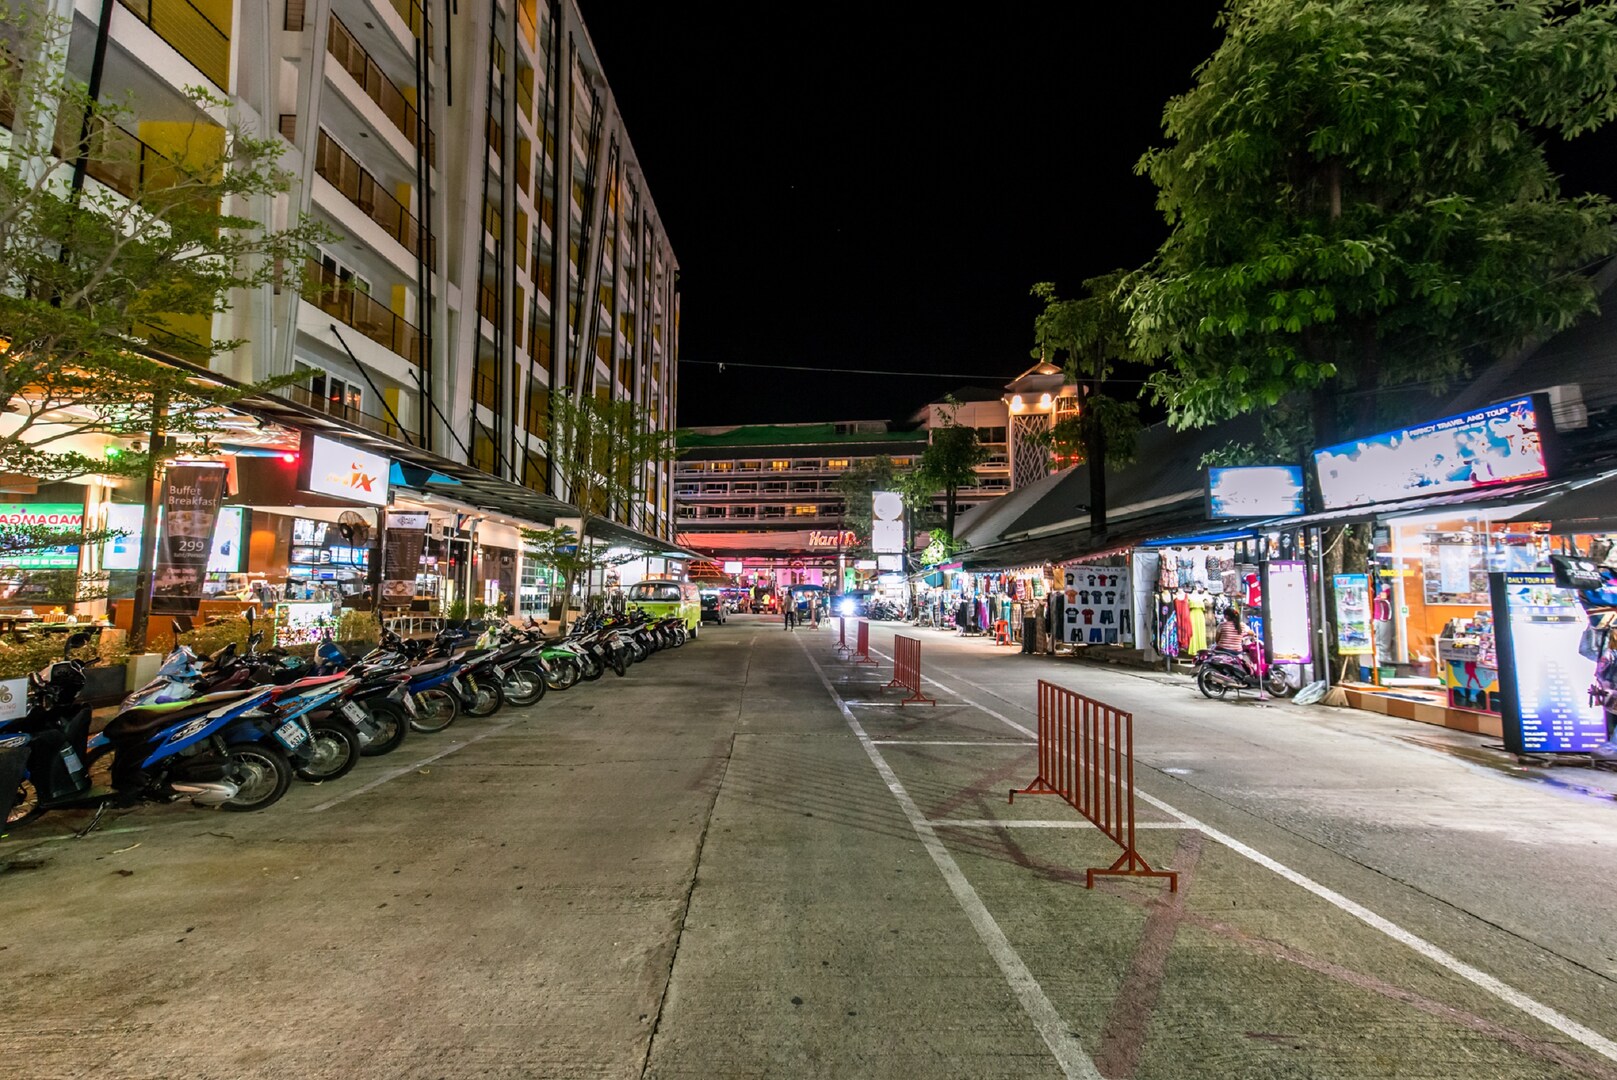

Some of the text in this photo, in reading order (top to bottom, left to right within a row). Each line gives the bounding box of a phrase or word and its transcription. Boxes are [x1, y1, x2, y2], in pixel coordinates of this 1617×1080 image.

[1436, 419, 1465, 431] TRAVEL
[1466, 413, 1484, 422] AND
[1485, 407, 1509, 418] TOUR
[169, 485, 201, 496] Buffet
[168, 496, 217, 507] Breakfast
[809, 531, 844, 546] Hard
[179, 540, 204, 552] 299
[1507, 576, 1523, 584] DAILY
